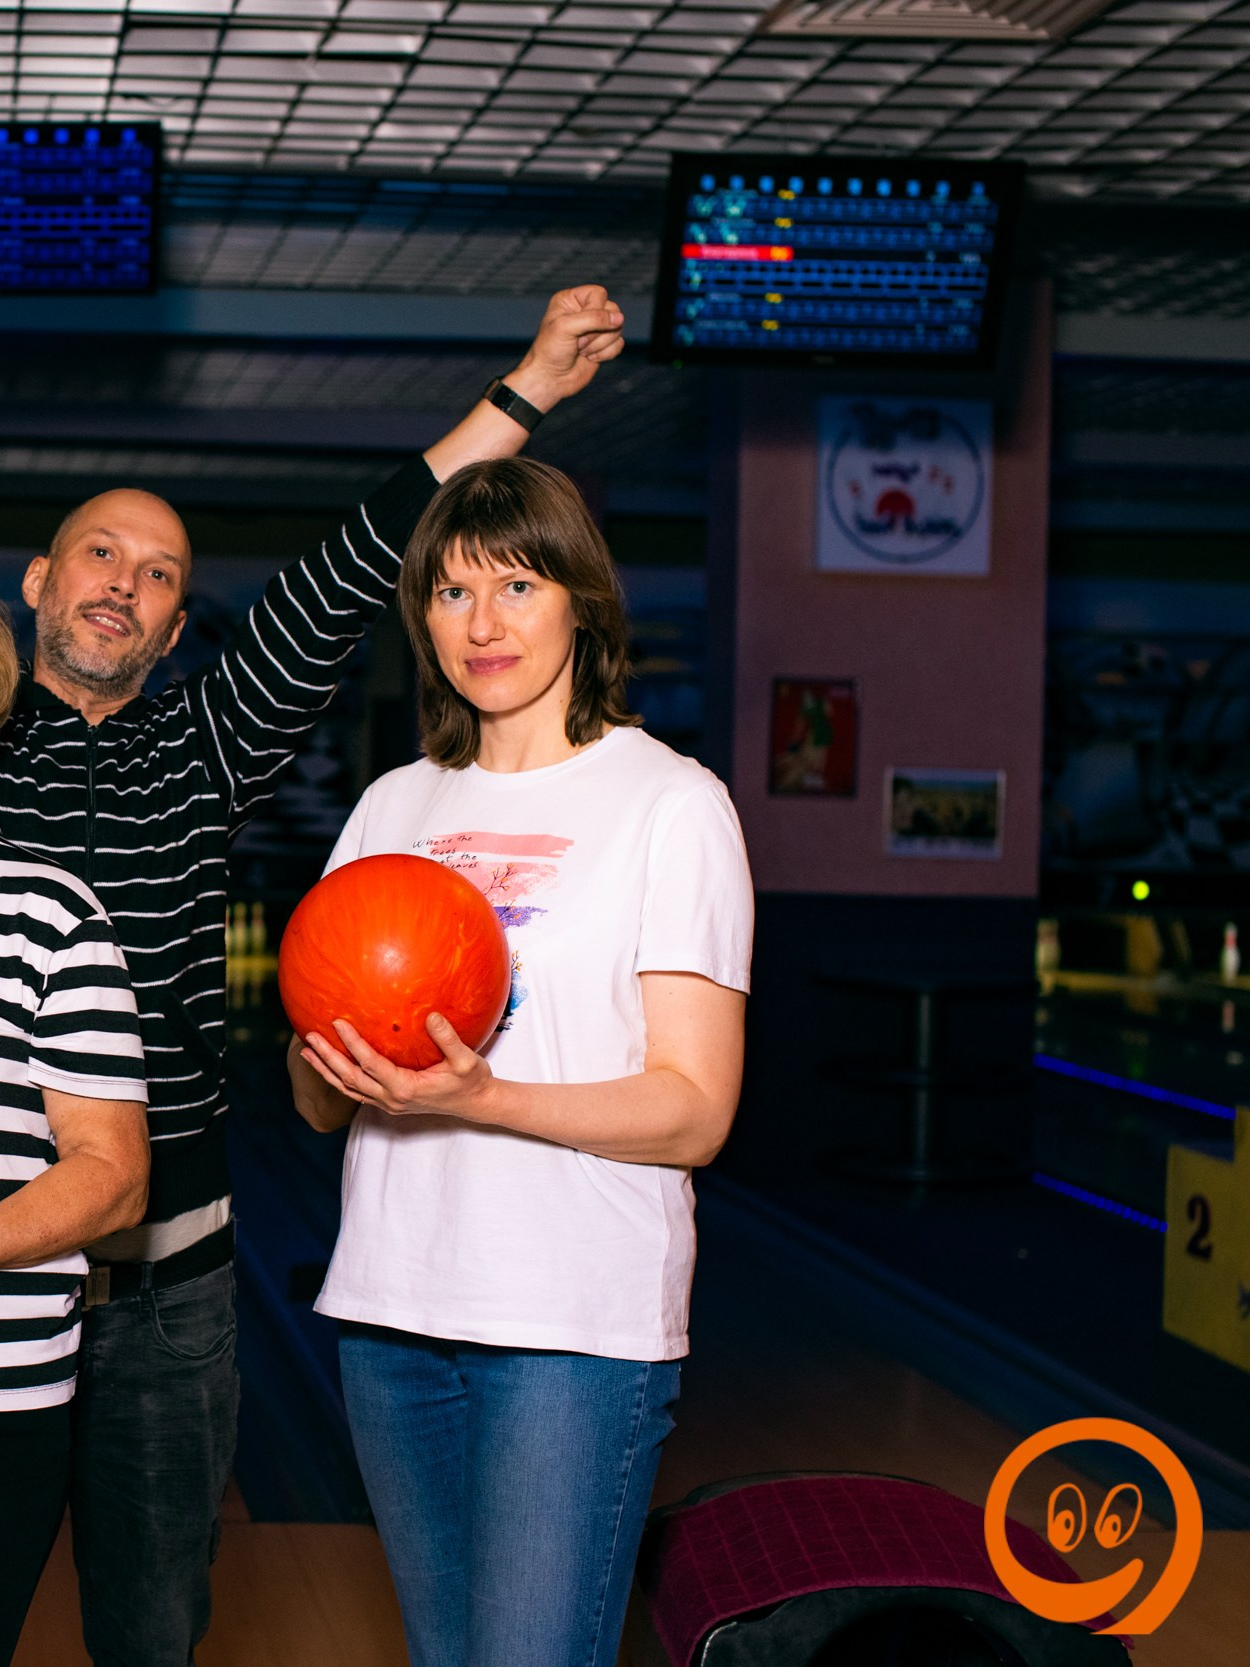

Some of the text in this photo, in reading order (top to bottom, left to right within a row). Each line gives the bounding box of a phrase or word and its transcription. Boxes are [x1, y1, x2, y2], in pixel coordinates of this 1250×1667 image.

[412, 838, 453, 848] Where
[430, 847, 457, 856] trees
[461, 852, 477, 860] the
[1185, 1193, 1214, 1264] 2
